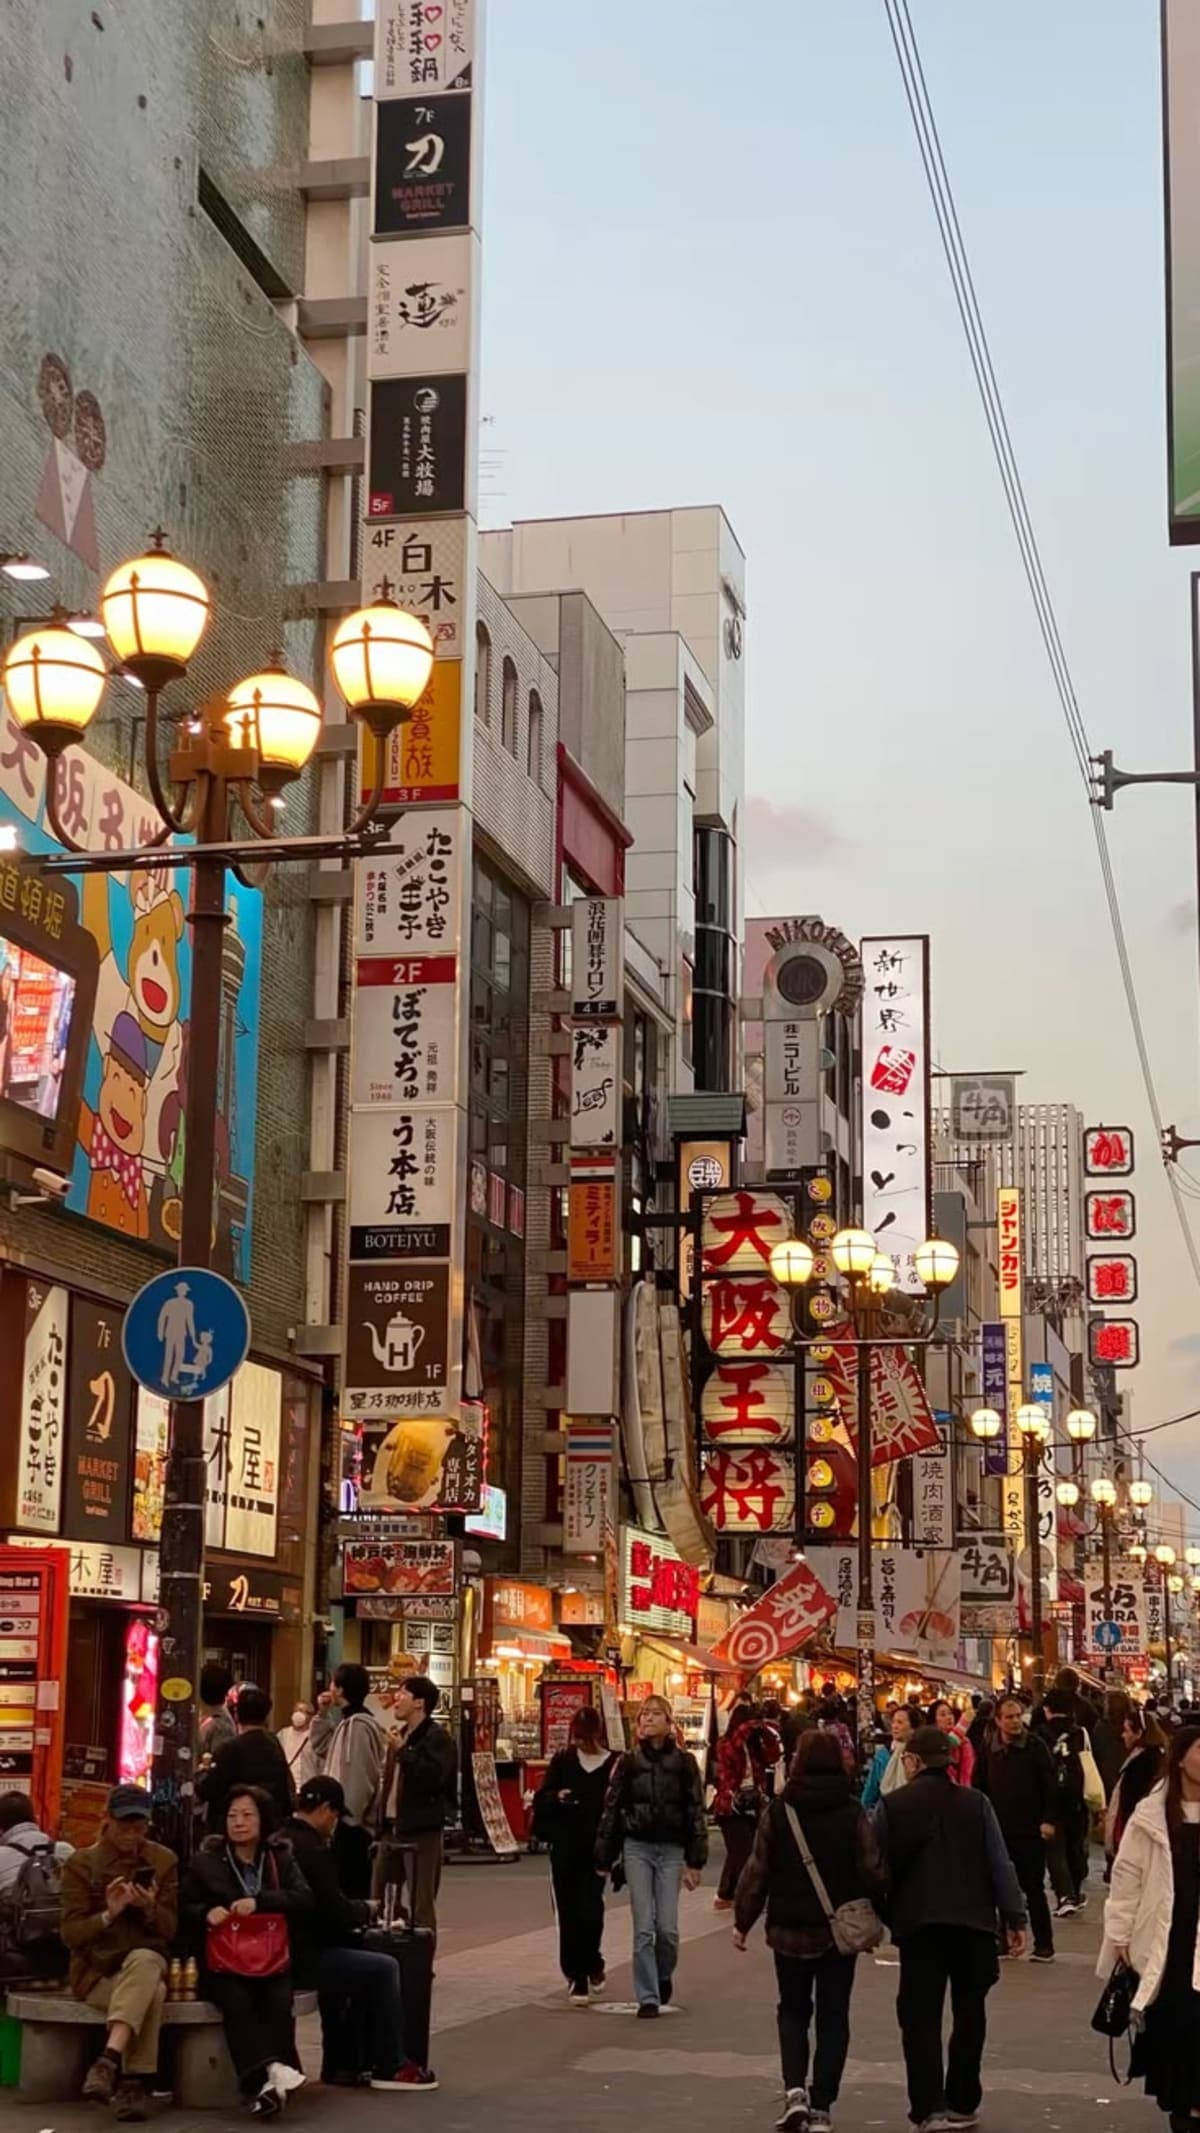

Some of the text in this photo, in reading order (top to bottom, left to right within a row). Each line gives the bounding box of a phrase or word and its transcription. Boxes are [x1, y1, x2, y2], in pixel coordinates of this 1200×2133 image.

[414, 107, 435, 125] 7F
[404, 133, 445, 174] 刀
[392, 182, 455, 200] MARKET
[399, 196, 445, 212] GRILL
[372, 497, 390, 513] 5F
[371, 529, 396, 548] 4F
[399, 788, 422, 801] 3F
[425, 827, 453, 939] たこやき
[393, 963, 422, 984] 2F
[873, 949, 912, 1032] 新世界
[582, 1002, 608, 1013] 4F
[385, 1115, 420, 1216] う本店
[365, 1232, 436, 1249] BOTEJYU
[1000, 1200, 1019, 1292] ジャンカラ
[27, 1286, 42, 1310] 3F
[364, 1279, 434, 1293] HAND DRIP
[374, 1292, 424, 1304] COFFEE
[97, 1320, 112, 1349] 7F
[389, 1341, 408, 1366] H
[700, 1191, 786, 1531] 大阪王将
[425, 1364, 443, 1379] 1F
[44, 1322, 62, 1488] たこやき
[86, 1371, 115, 1439] 刀
[78, 1455, 119, 1482] MARKET
[444, 1456, 461, 1503] 専門店
[82, 1480, 112, 1504] GRILL
[921, 1461, 945, 1545] 焼肉酒家
[961, 1547, 1009, 1587] 牛角
[229, 1574, 249, 1612] 刀
[768, 1581, 828, 1638] 射
